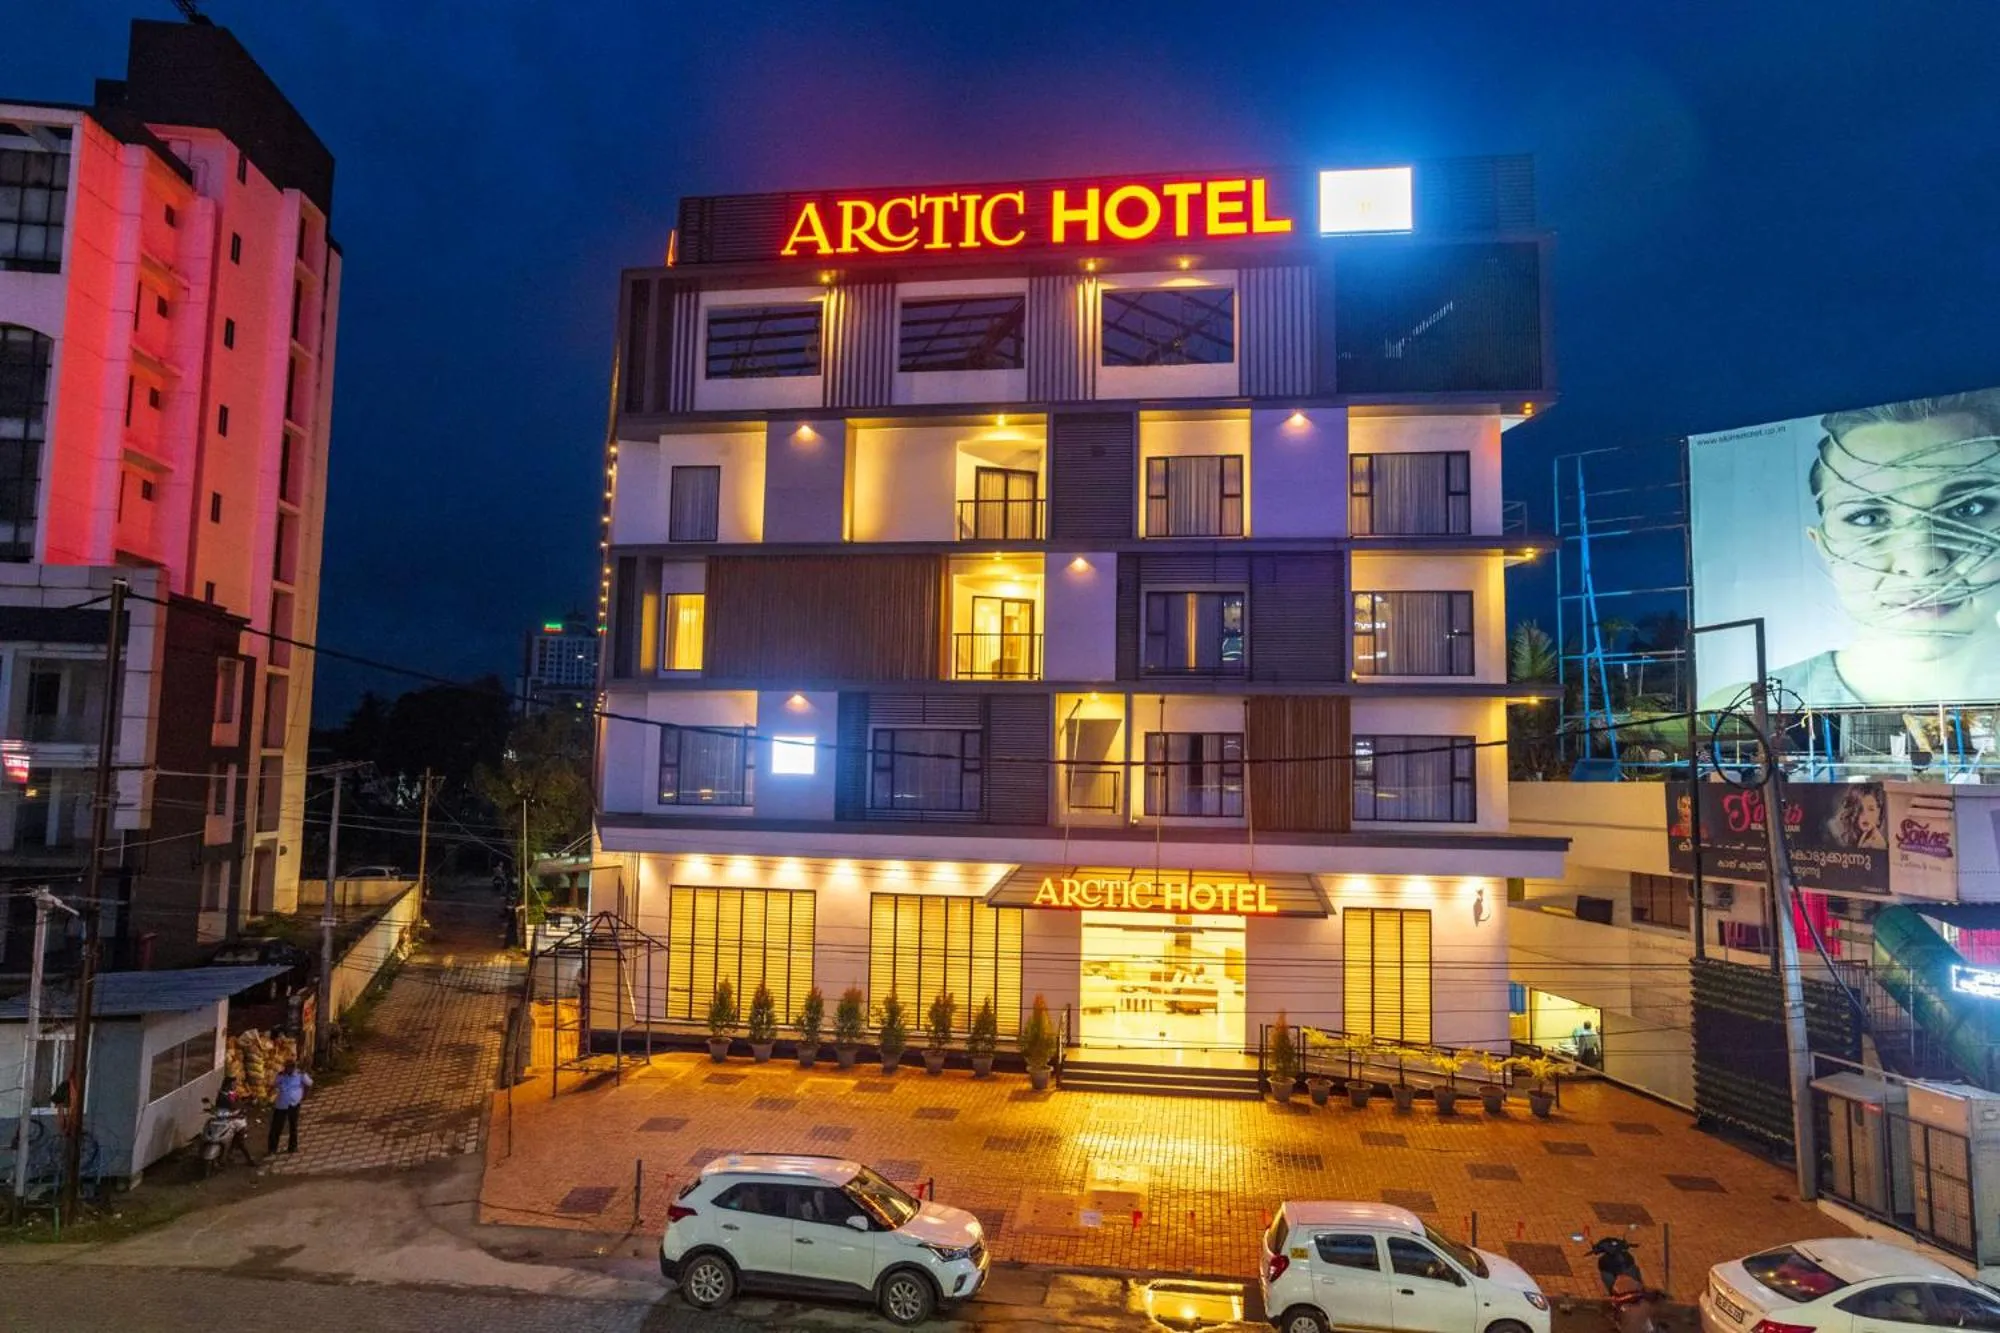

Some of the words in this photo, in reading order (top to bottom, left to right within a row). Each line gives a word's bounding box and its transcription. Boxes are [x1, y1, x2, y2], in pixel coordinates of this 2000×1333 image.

[780, 190, 1026, 256] ARCTIC
[1052, 178, 1292, 243] HOTEL
[1033, 878, 1153, 909] ARCTIC
[1164, 882, 1278, 913] HOTEL
